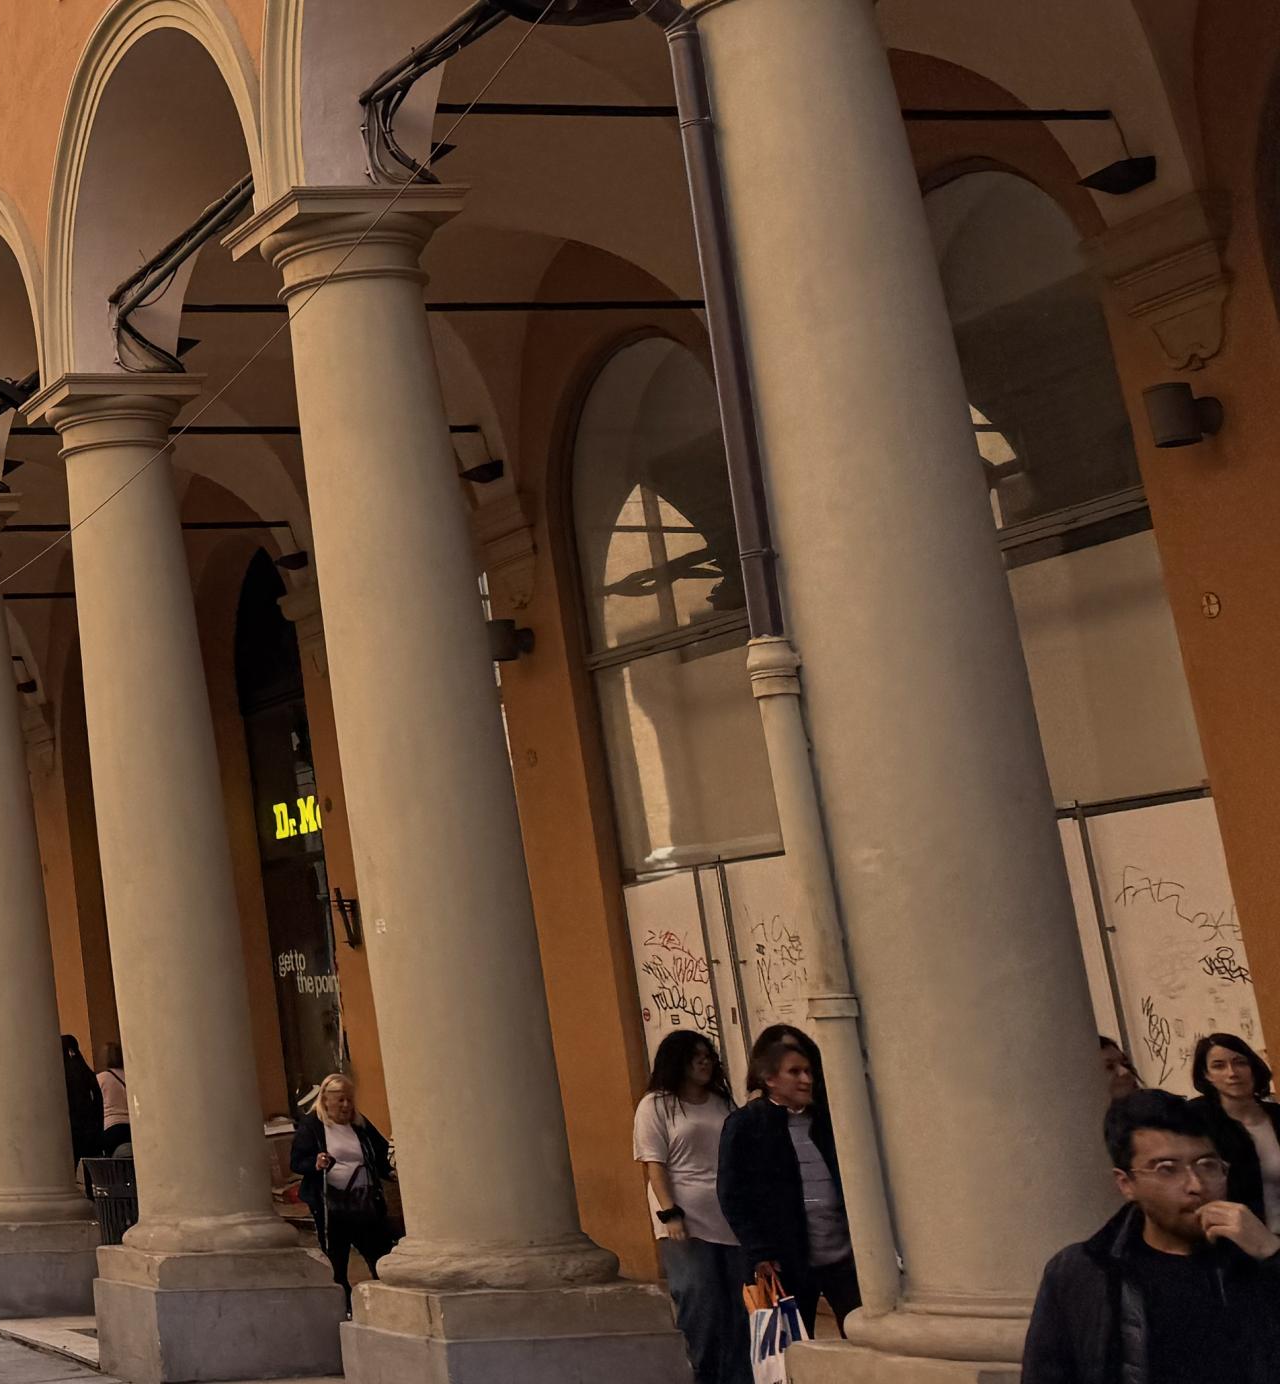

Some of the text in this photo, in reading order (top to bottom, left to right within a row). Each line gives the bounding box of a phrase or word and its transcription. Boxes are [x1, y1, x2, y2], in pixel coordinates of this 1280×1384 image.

[297, 795, 322, 834] M
[278, 949, 306, 977] get to
[297, 970, 315, 993] the
